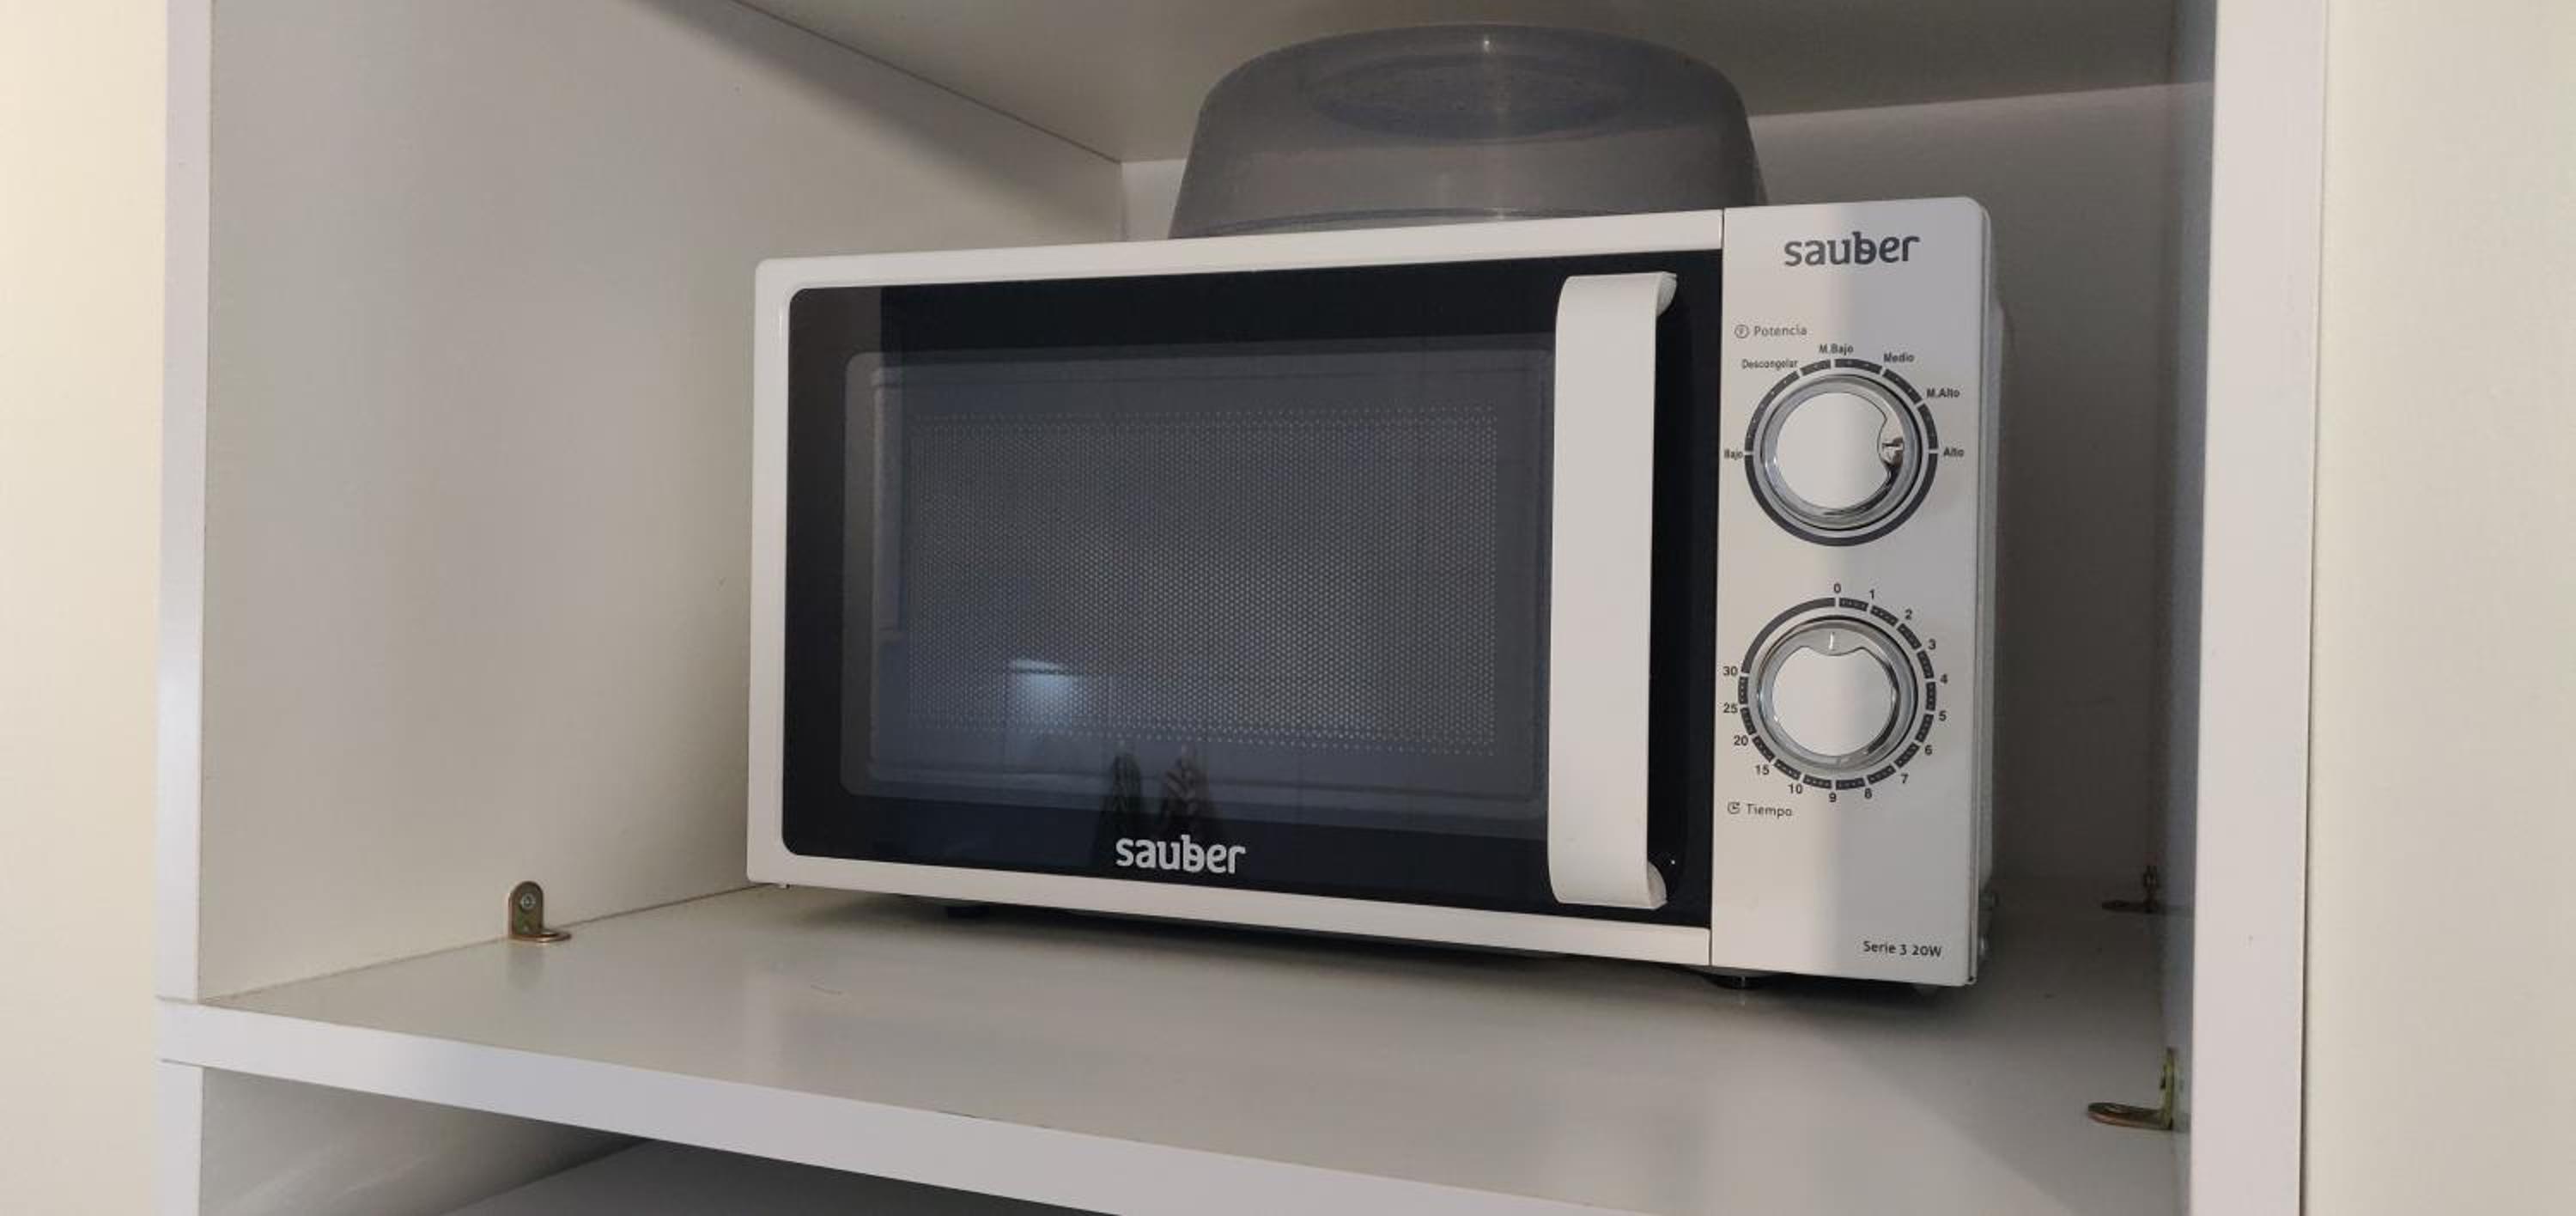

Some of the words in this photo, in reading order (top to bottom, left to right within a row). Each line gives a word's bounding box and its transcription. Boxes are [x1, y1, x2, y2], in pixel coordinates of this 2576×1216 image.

[1784, 231, 1921, 266] sauber
[1753, 325, 1807, 337] Potencia
[1819, 344, 1854, 356] M.Bajo
[1883, 352, 1915, 363] Medio
[1741, 358, 1799, 370] Descongelar
[1926, 387, 1961, 398] M.Alto
[1723, 447, 1743, 461] Bajo
[1943, 446, 1965, 458] Alto
[1832, 582, 1842, 594] 0
[1868, 588, 1875, 600] 1
[1904, 608, 1913, 621] 2
[1927, 638, 1937, 651] 3
[1722, 665, 1739, 678] 30
[1939, 673, 1948, 684] 4
[1722, 702, 1739, 714] 25
[1938, 709, 1947, 722] 5
[1733, 734, 1749, 746] 20
[1923, 743, 1933, 756] 6
[1754, 764, 1771, 776] 15
[1900, 772, 1910, 785] 7
[1788, 782, 1804, 795] 10
[1863, 787, 1873, 800] 8
[1828, 792, 1838, 803] 9
[1747, 803, 1793, 818] Tiempo
[1115, 834, 1247, 874] sauber
[1862, 939, 1897, 955] Serie
[1899, 943, 1908, 956] 3
[1911, 944, 1942, 958] 20W
